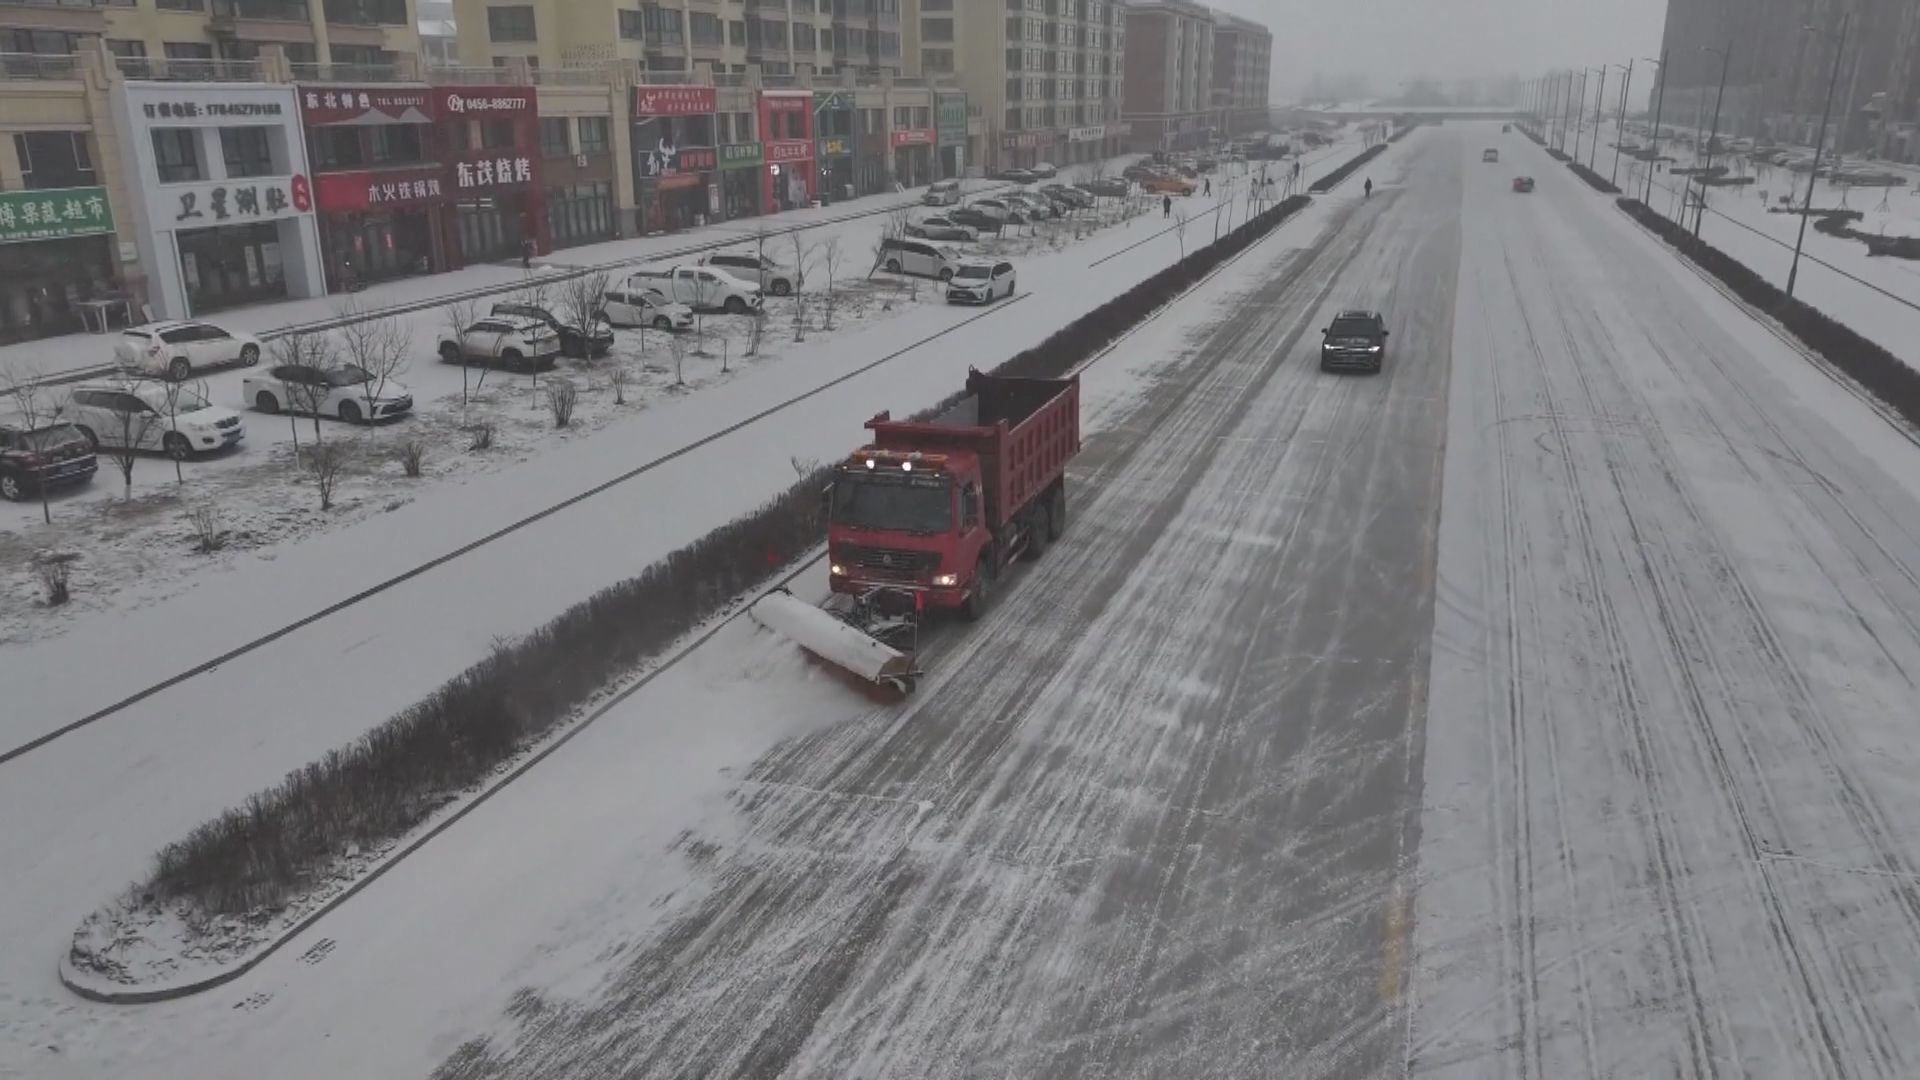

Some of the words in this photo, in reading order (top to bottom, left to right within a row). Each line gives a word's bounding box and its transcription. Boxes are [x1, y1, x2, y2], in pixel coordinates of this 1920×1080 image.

[307, 92, 370, 110] 东北特色
[457, 158, 532, 187] 东茂烧烤
